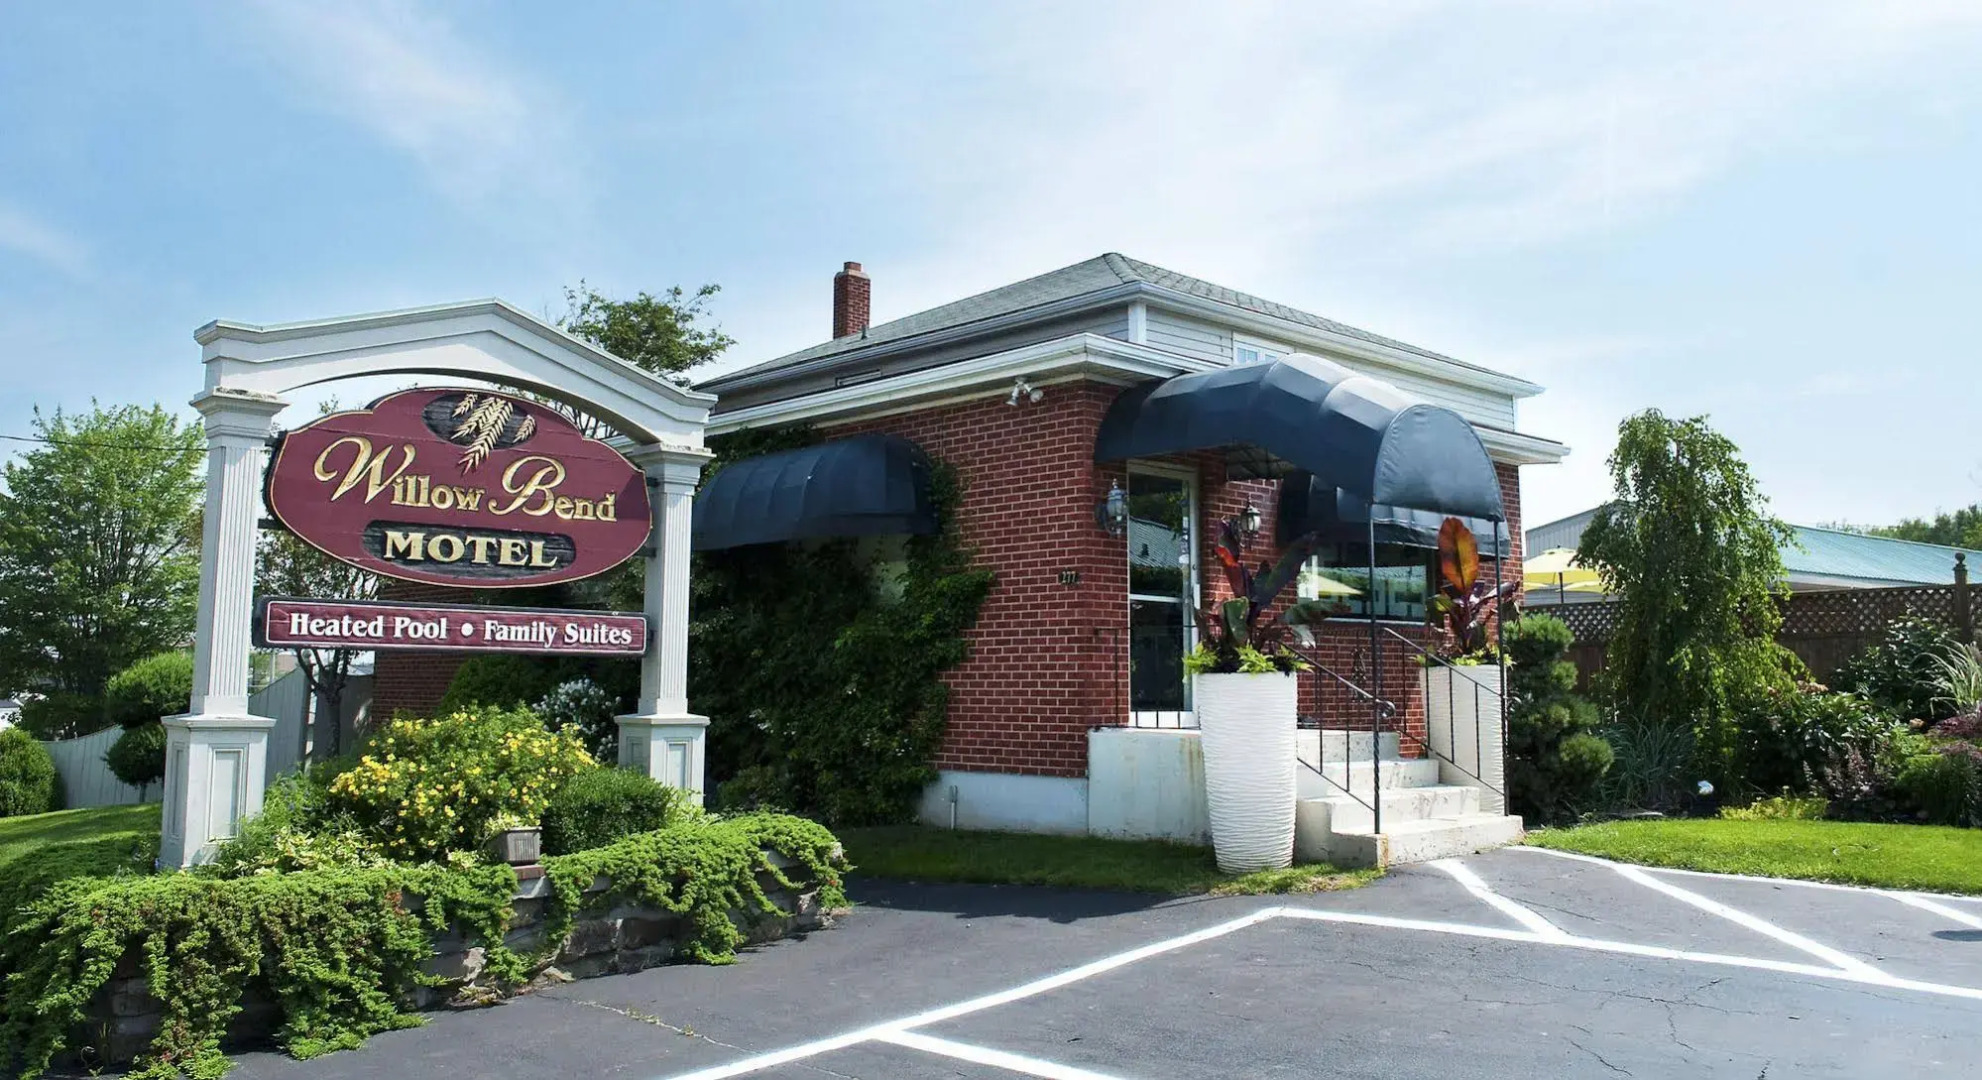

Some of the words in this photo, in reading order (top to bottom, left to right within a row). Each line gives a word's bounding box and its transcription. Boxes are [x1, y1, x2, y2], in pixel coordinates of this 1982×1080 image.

[314, 437, 486, 511] Willow
[488, 456, 617, 522] Bend
[383, 530, 558, 568] MOTEL
[289, 612, 384, 638] Heated
[393, 616, 448, 639] Pool
[483, 619, 558, 647] Family
[564, 624, 632, 645] Suites
